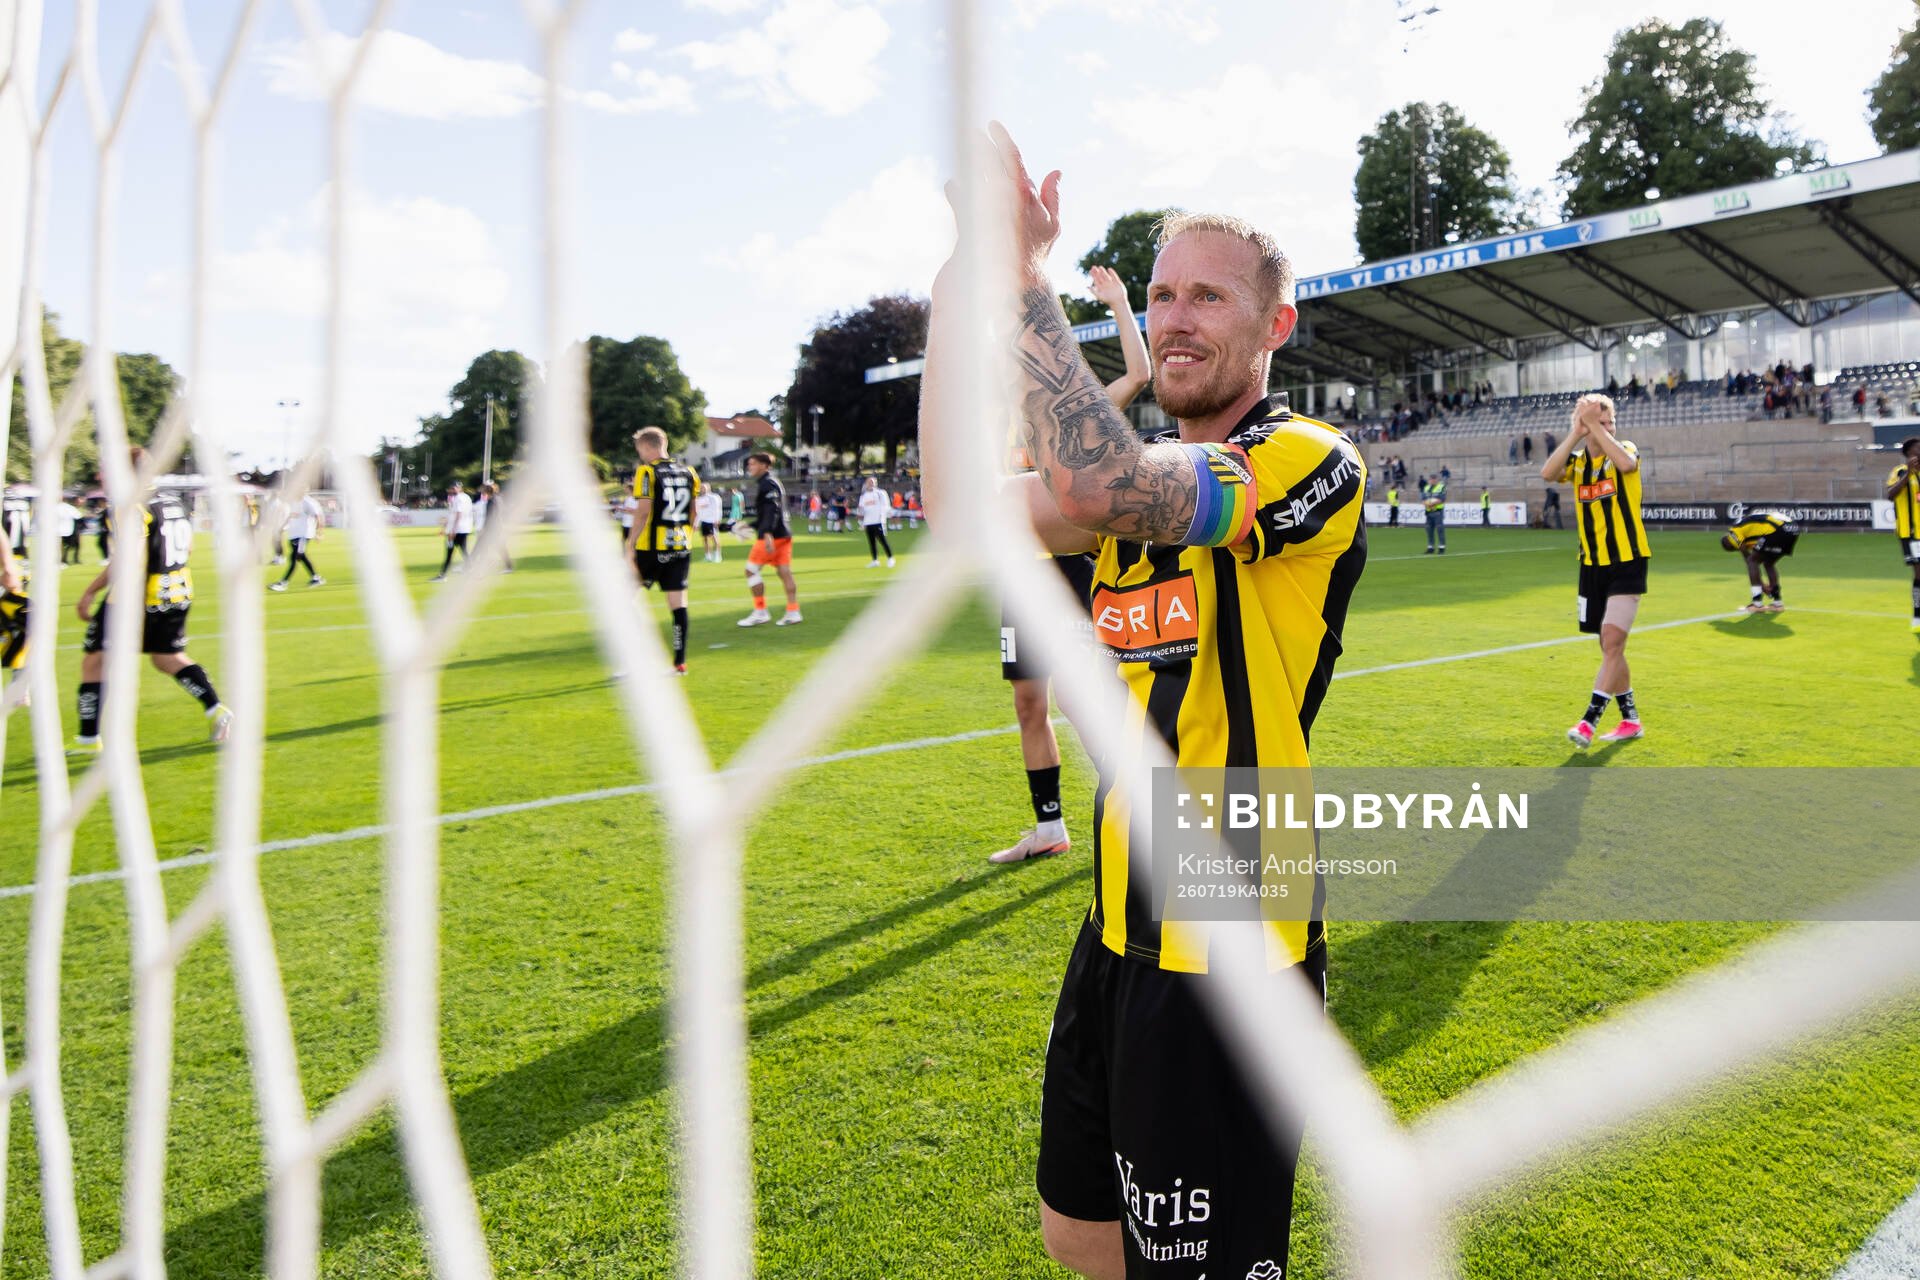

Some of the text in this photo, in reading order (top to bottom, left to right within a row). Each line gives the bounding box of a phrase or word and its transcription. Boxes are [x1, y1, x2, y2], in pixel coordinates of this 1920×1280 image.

[1350, 270, 1372, 287] VI
[1384, 248, 1481, 281] STÖDJER
[1495, 234, 1547, 259] HBK
[1114, 1151, 1211, 1228] Varis
